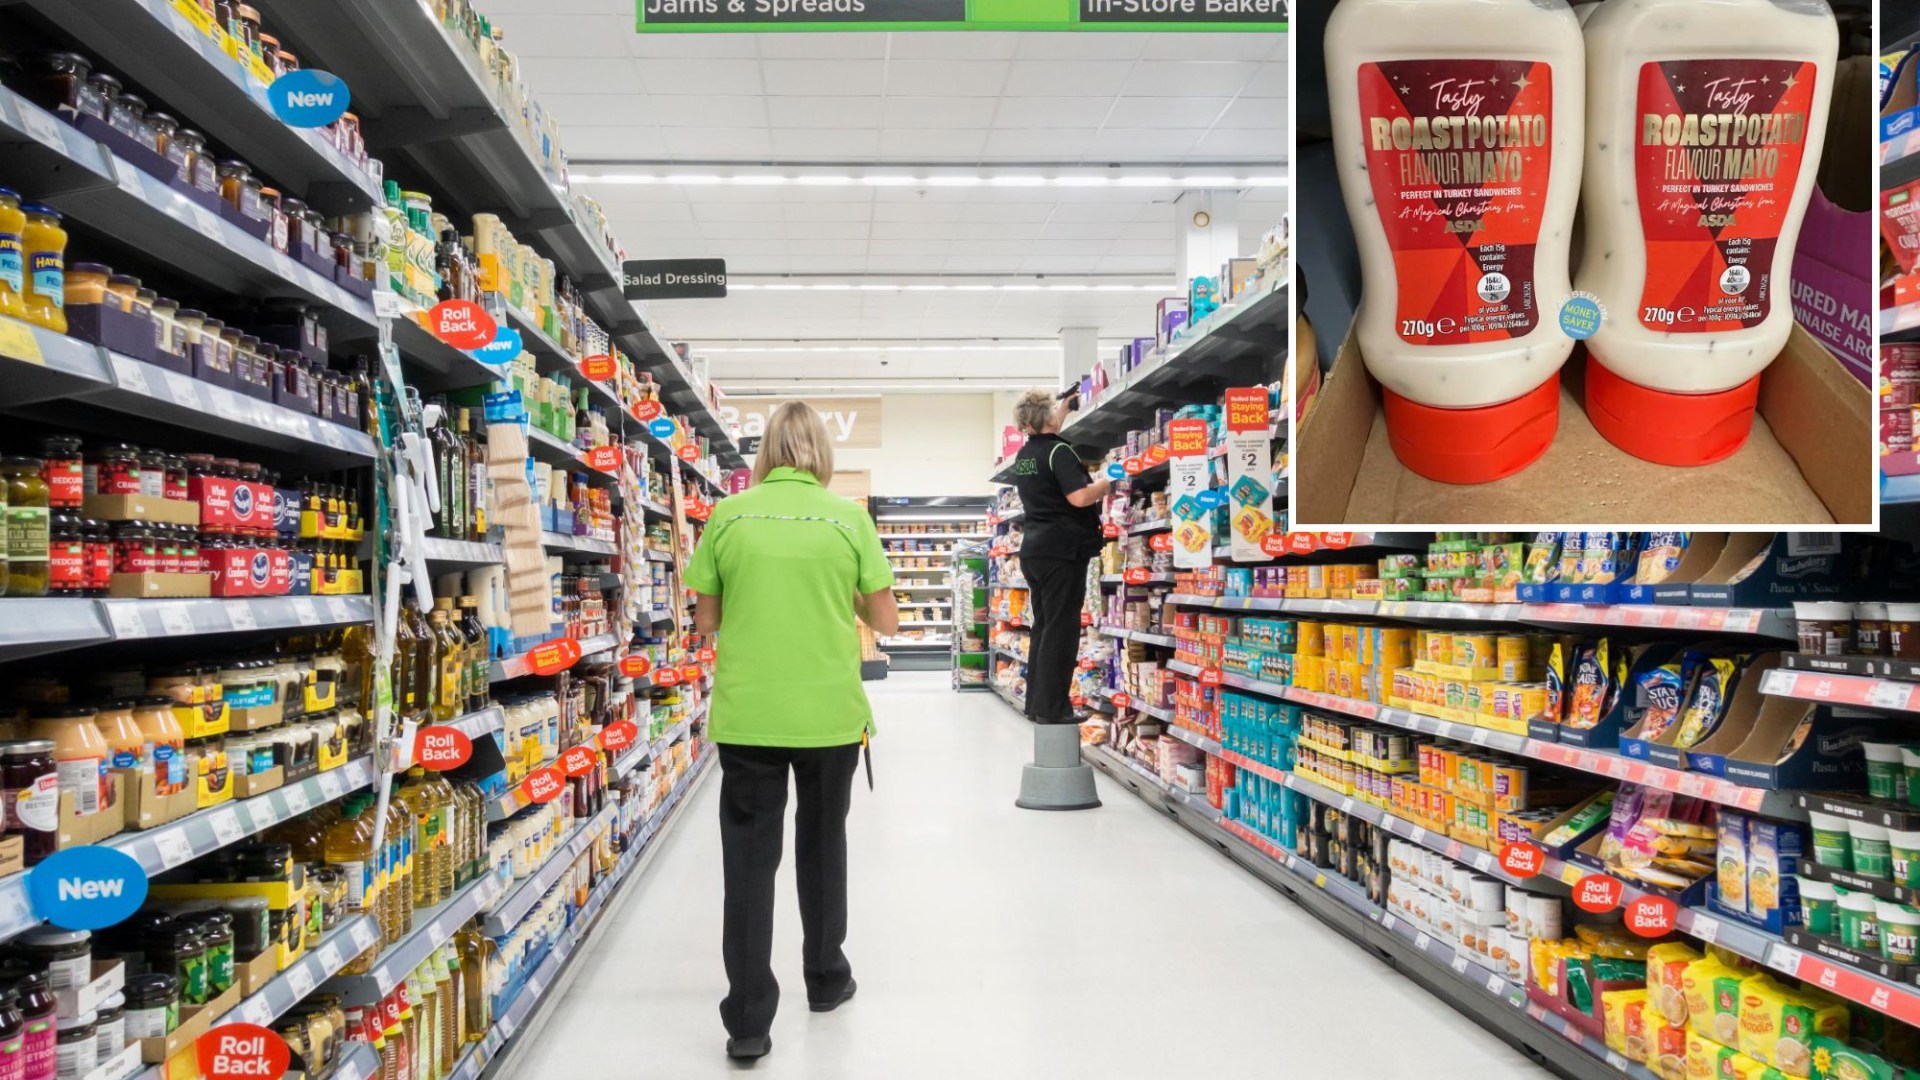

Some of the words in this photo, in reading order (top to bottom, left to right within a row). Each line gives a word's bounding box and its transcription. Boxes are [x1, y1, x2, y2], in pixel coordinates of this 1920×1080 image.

[647, 0, 718, 13] Jams
[727, 0, 745, 13] &
[754, 0, 865, 16] Spreads
[1088, 0, 1195, 13] In-Store
[287, 91, 333, 108] New
[1429, 78, 1485, 118] Tasty
[1704, 77, 1756, 117] Tasty
[1370, 116, 1464, 151] ROAST
[1467, 114, 1546, 149] POTATO
[1643, 114, 1733, 146] ROAST
[1734, 114, 1805, 145] POTATO
[1400, 153, 1460, 185] FLAVOUR
[1463, 151, 1522, 184] MAYO
[1665, 149, 1721, 181] FLAVOUR
[1723, 148, 1779, 179] MAYO
[1401, 190, 1432, 199] PERFECT
[1433, 190, 1442, 198] IN
[1443, 189, 1472, 198] TURKEY
[1473, 187, 1521, 197] SANDWICHES
[1662, 184, 1691, 193] PERFECT
[1692, 184, 1700, 193] IN
[1702, 184, 1729, 193] TURKEY
[1730, 183, 1774, 192] SANDWICHES
[1413, 203, 1452, 222] Magical
[1455, 201, 1503, 217] Christmas
[1671, 197, 1708, 215] Magical
[1710, 196, 1753, 212] Christmas
[1444, 220, 1486, 233] ASDA
[1697, 214, 1736, 227] ASDA
[1480, 244, 1494, 252] Each
[1728, 238, 1741, 246] Each
[623, 274, 661, 286] Salad
[666, 272, 725, 287] Dressing
[442, 308, 470, 321] Roll
[1644, 308, 1674, 324] 270g
[440, 320, 476, 334] Back
[1403, 320, 1434, 337] 270g
[638, 403, 652, 411] Roll
[639, 409, 656, 418] Back
[1231, 402, 1264, 412] Staying
[1173, 431, 1203, 440] Staying
[596, 451, 614, 459] Roll
[1242, 453, 1257, 466] £2
[595, 458, 617, 467] Back
[1182, 475, 1196, 487] £2
[1268, 537, 1283, 545] Roll
[1295, 534, 1310, 542] Roll
[1326, 536, 1346, 545] Back
[1266, 544, 1285, 552] Back
[1292, 542, 1311, 550] Back
[1769, 583, 1794, 593] Pasta
[537, 656, 561, 668] Back
[606, 730, 622, 738] Roll
[606, 736, 626, 745] Back
[425, 735, 454, 749] Roll
[423, 747, 460, 761] Back
[565, 751, 586, 763] Roll
[567, 759, 592, 774] Back
[530, 772, 551, 789] Roll
[532, 781, 557, 799] Back
[1824, 803, 1833, 811] YOU
[1511, 847, 1532, 861] Roll
[1506, 858, 1534, 872] Back
[1830, 872, 1840, 881] YOU
[58, 877, 124, 901] New
[1585, 881, 1609, 893] Roll
[1581, 892, 1613, 905] Back
[1638, 903, 1663, 916] Roll
[1635, 914, 1668, 928] Back
[1886, 932, 1917, 949] POT
[1818, 944, 1828, 953] YOU
[219, 1036, 265, 1055] Roll
[213, 1055, 270, 1075] Back
